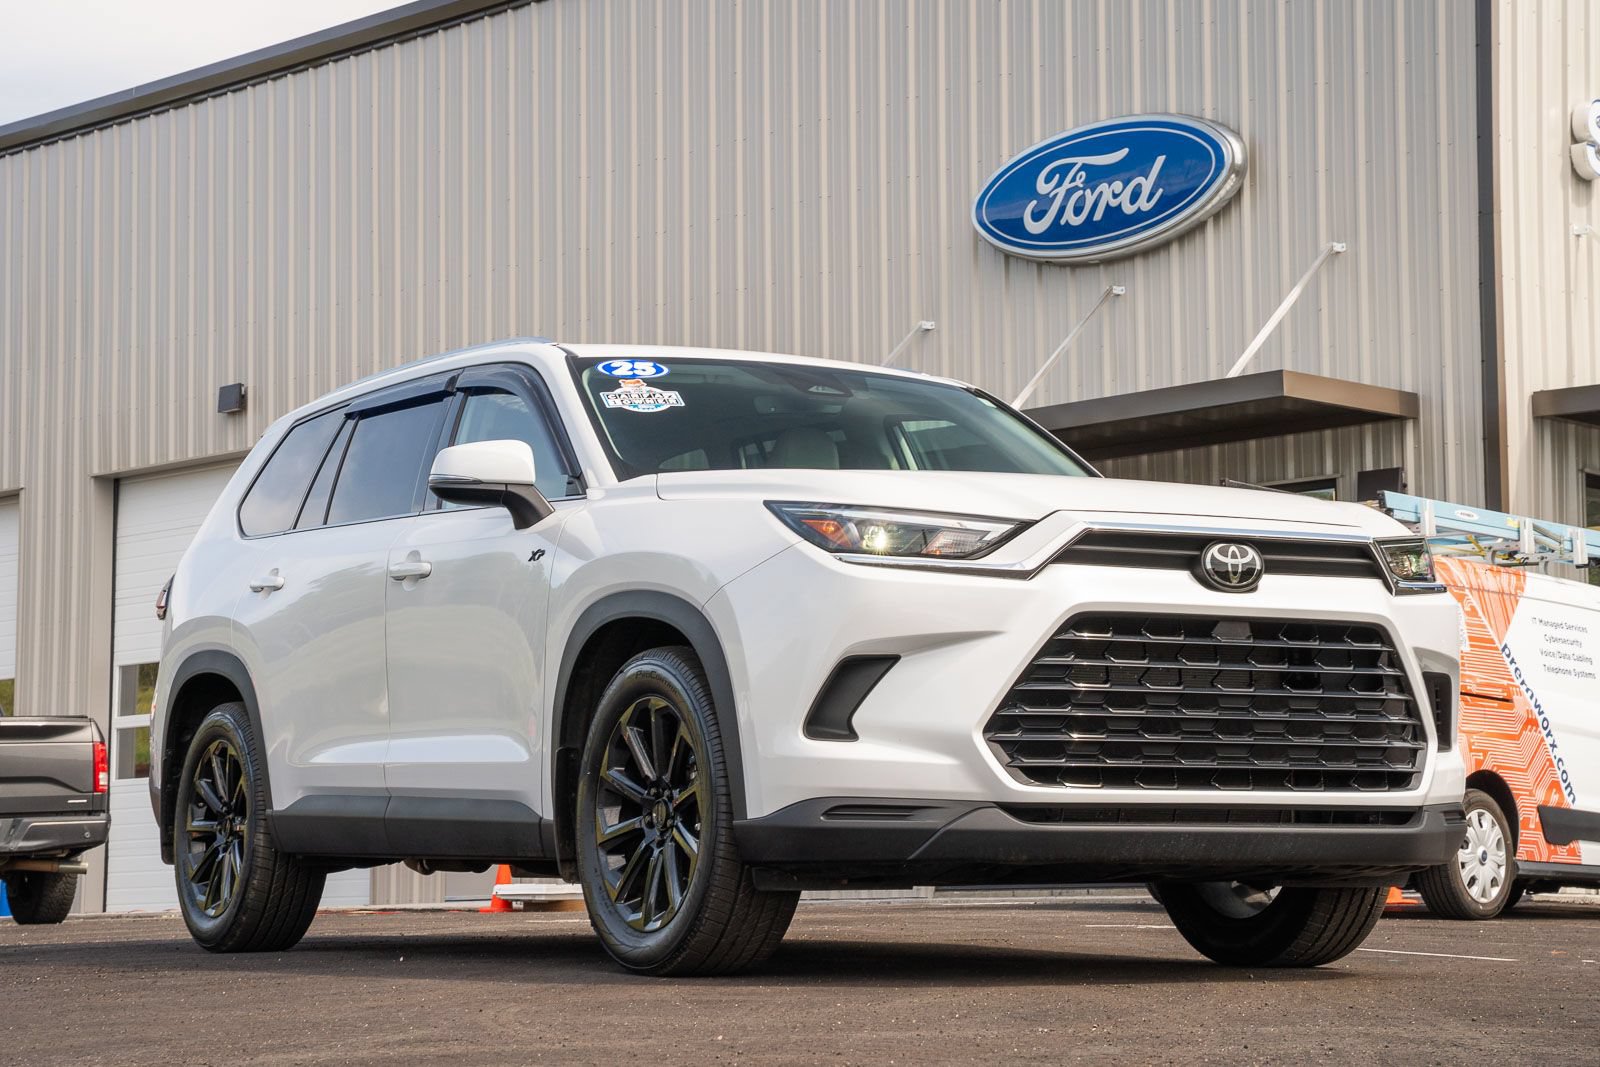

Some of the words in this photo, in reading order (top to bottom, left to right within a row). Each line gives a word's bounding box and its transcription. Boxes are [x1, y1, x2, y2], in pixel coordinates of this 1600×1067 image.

[1023, 147, 1167, 235] Ford
[610, 361, 657, 376] 25
[1538, 617, 1564, 630] Managed
[1564, 621, 1588, 633] Services
[1543, 633, 1582, 649] Cybersecurity
[1571, 652, 1593, 666] Cabling
[1542, 663, 1572, 677] Telephone
[1572, 668, 1597, 680] Systems
